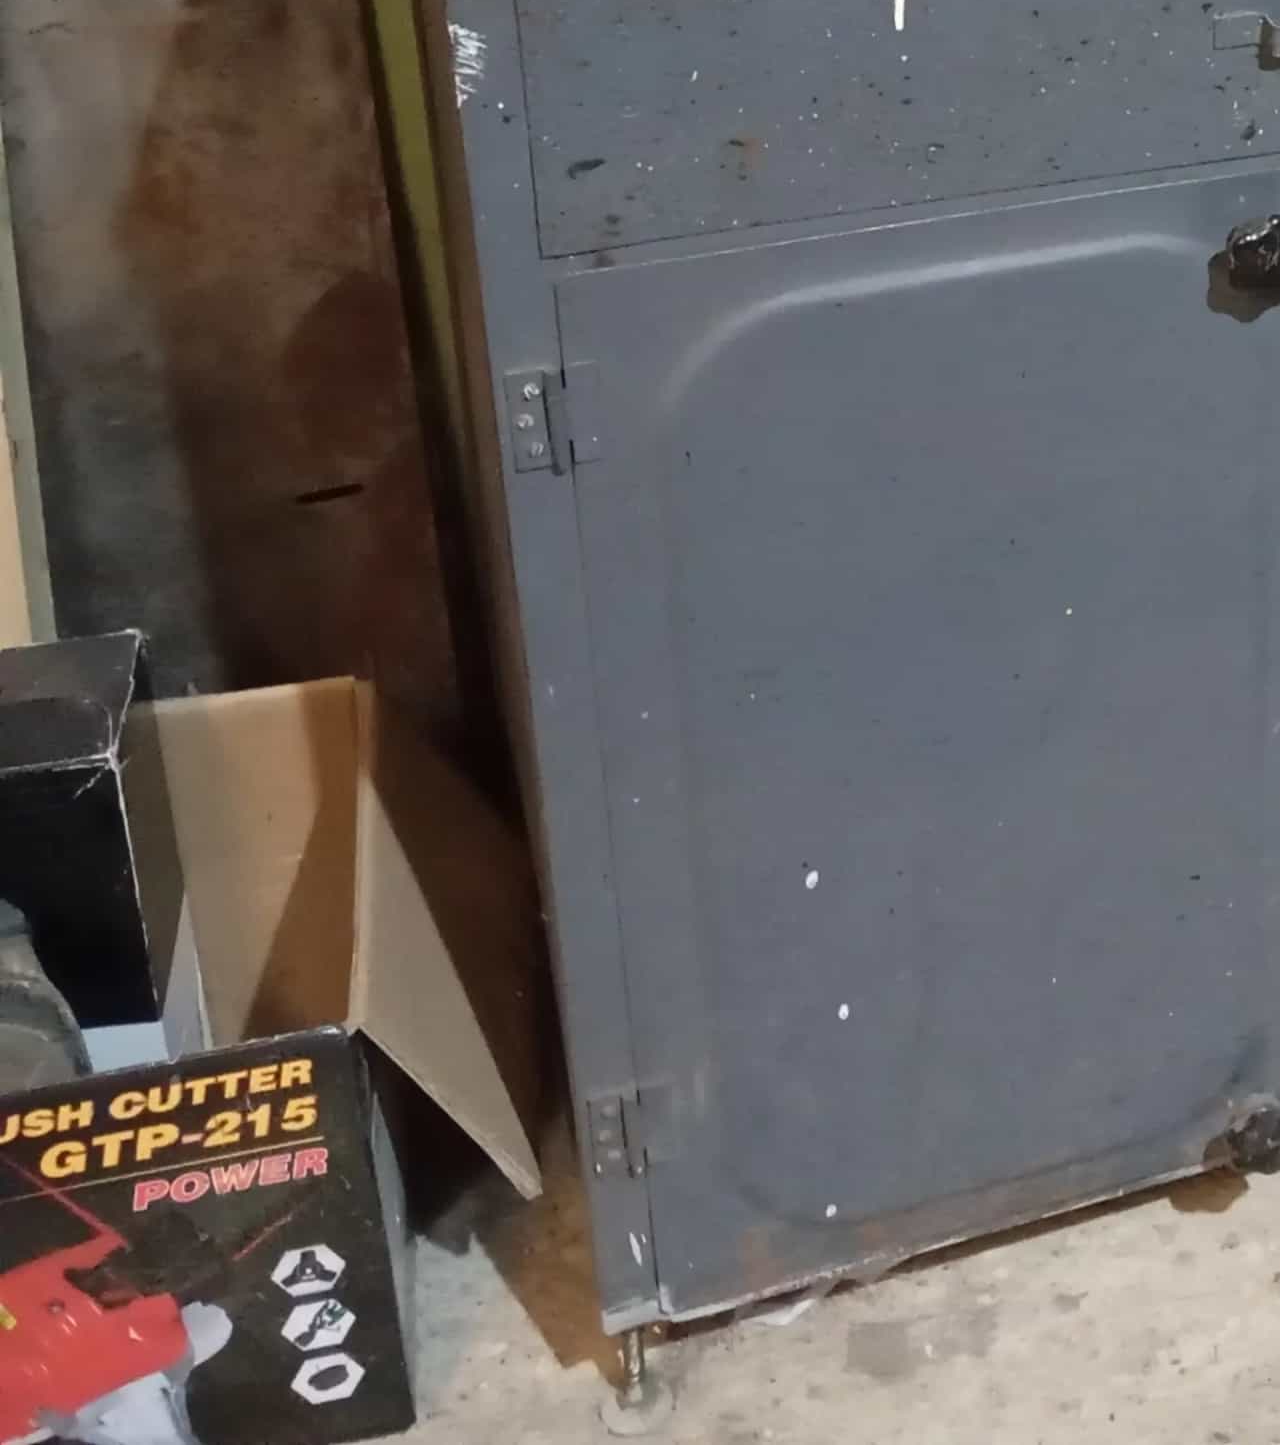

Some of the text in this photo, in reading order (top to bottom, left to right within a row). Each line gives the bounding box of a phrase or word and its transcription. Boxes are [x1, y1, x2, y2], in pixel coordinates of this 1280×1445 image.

[108, 1059, 313, 1120] CUTTER
[39, 1095, 318, 1178] GTP-215
[132, 1146, 328, 1212] POWER
